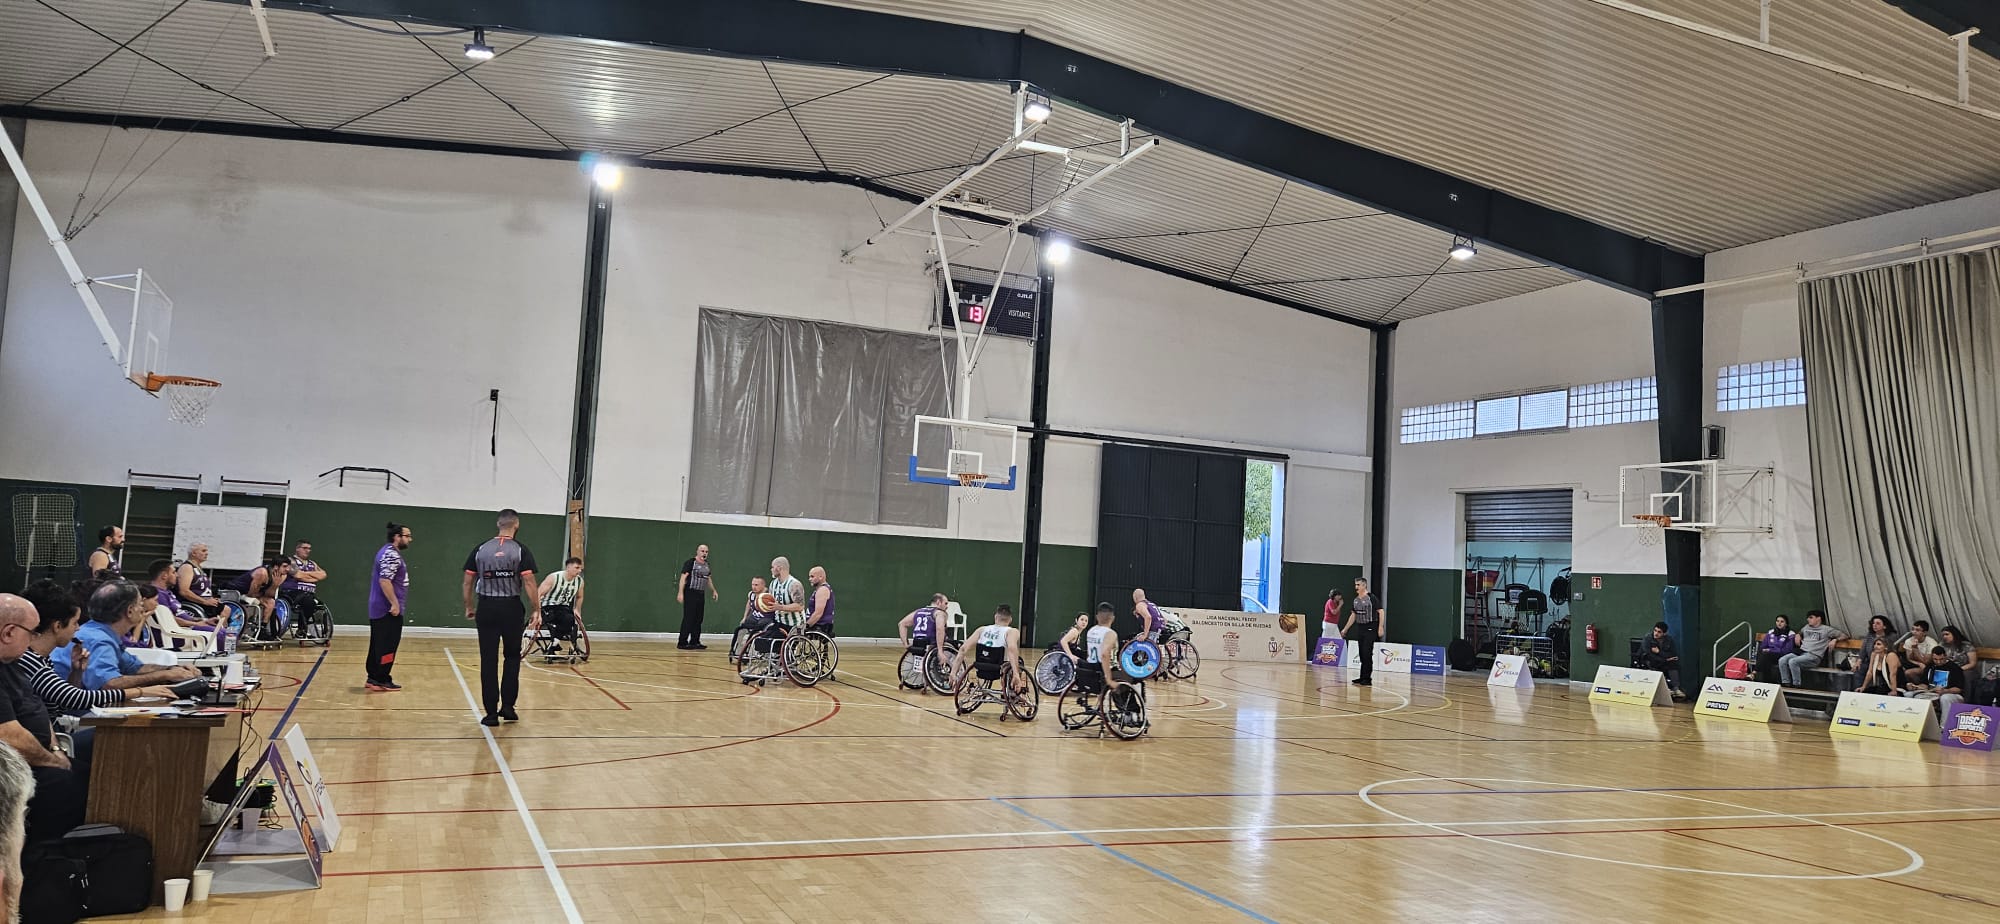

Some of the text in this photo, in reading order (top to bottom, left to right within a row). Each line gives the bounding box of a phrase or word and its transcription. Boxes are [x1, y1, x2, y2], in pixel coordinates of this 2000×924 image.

[969, 306, 983, 323] 13
[1008, 309, 1031, 319] VISITANTE
[914, 617, 928, 631] 23
[1753, 688, 1770, 697] OK
